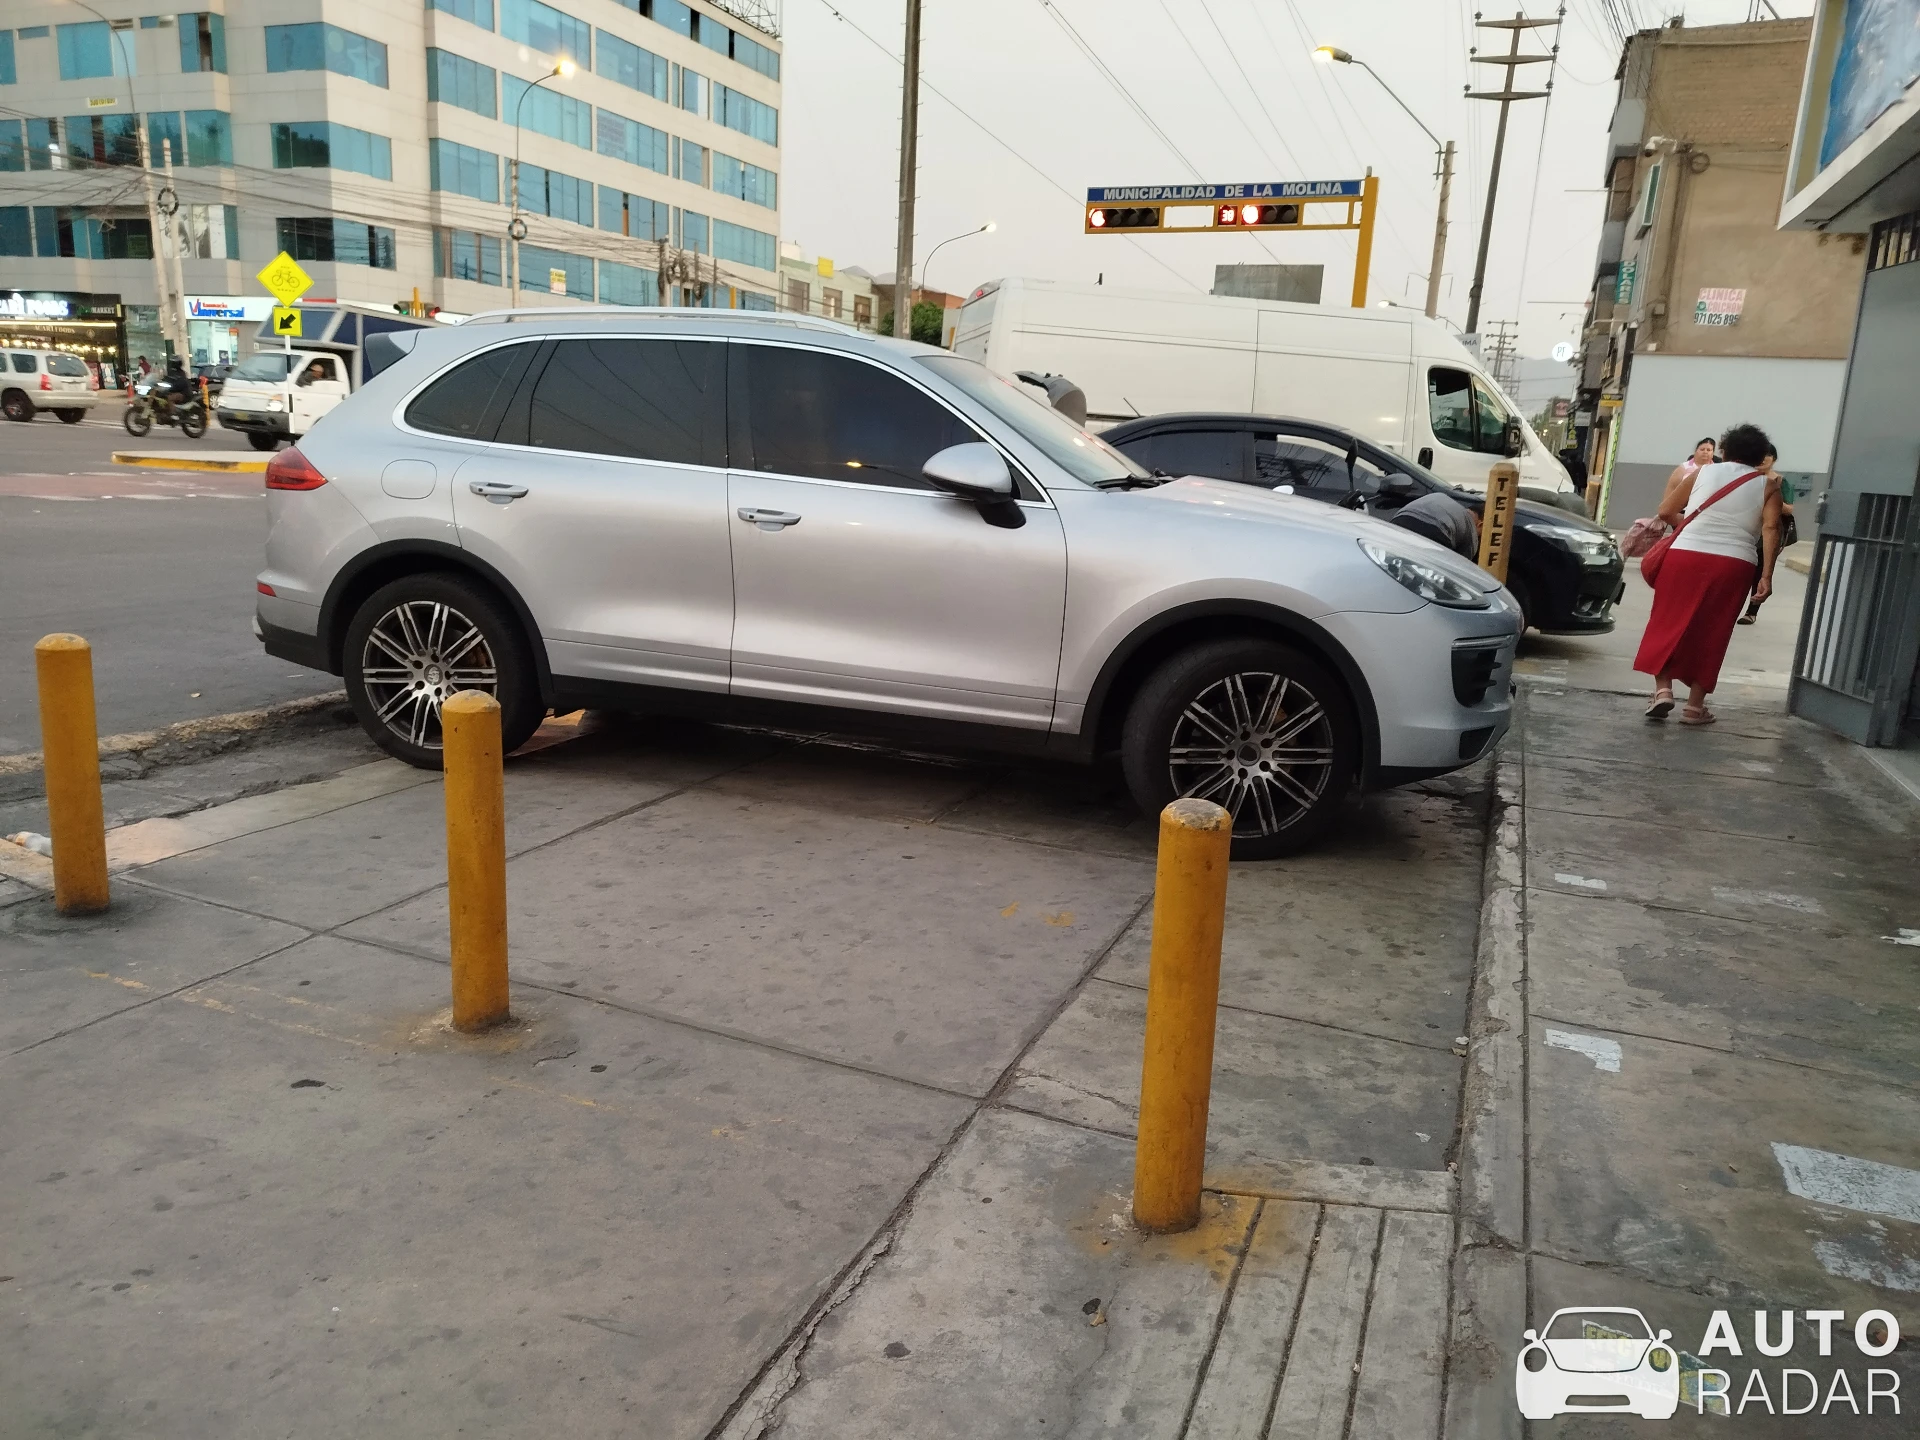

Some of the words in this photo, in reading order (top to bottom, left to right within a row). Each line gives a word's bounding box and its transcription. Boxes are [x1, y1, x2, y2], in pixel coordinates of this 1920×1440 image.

[1103, 186, 1216, 200] MUNICIPALIDAD
[1224, 185, 1244, 198] DE
[1252, 184, 1274, 197] LA
[1282, 182, 1343, 196] MOLINA
[1700, 289, 1744, 301] CLINICA
[1693, 312, 1707, 324] 971
[1707, 313, 1723, 325] 025
[1487, 477, 1509, 567] TELEF
